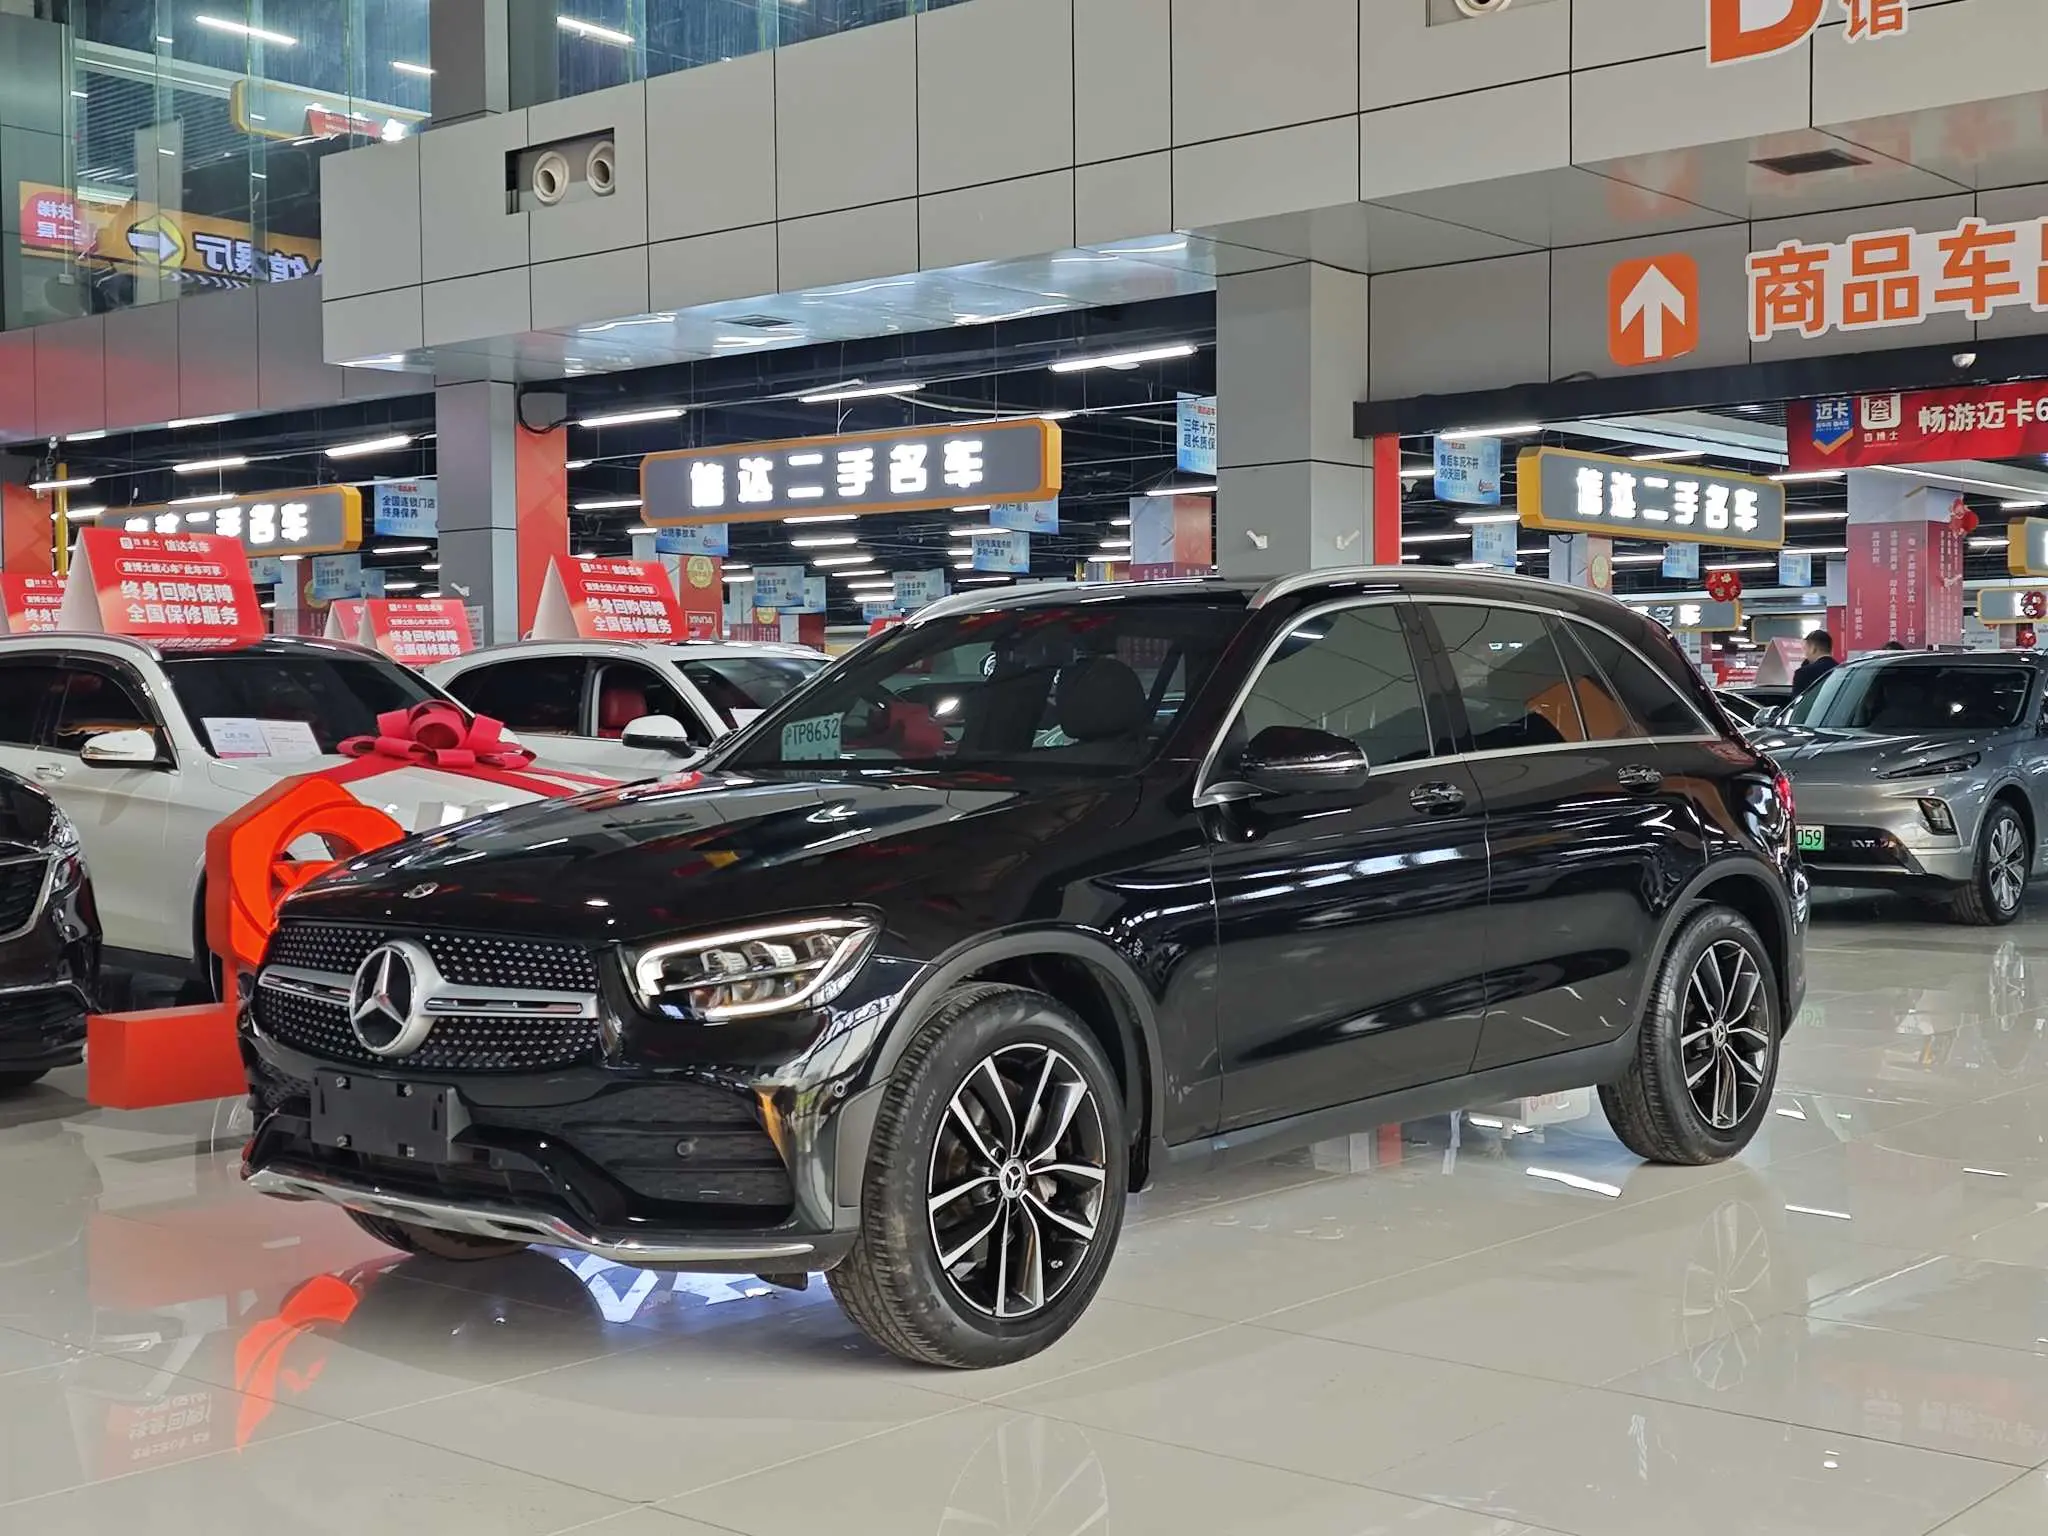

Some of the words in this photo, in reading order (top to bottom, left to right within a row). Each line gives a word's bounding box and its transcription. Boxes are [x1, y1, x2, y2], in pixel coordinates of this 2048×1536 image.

[1751, 224, 2048, 336] 商品车
[1815, 402, 1849, 421] 迈卡
[690, 439, 984, 507] 信达二手名车
[1576, 466, 1758, 532] 信达二手名车
[121, 580, 236, 603] 终身回购保障
[127, 604, 239, 626] 全国保修服务
[586, 597, 668, 617] 终身回购保障
[593, 615, 673, 634] 全国保修服务
